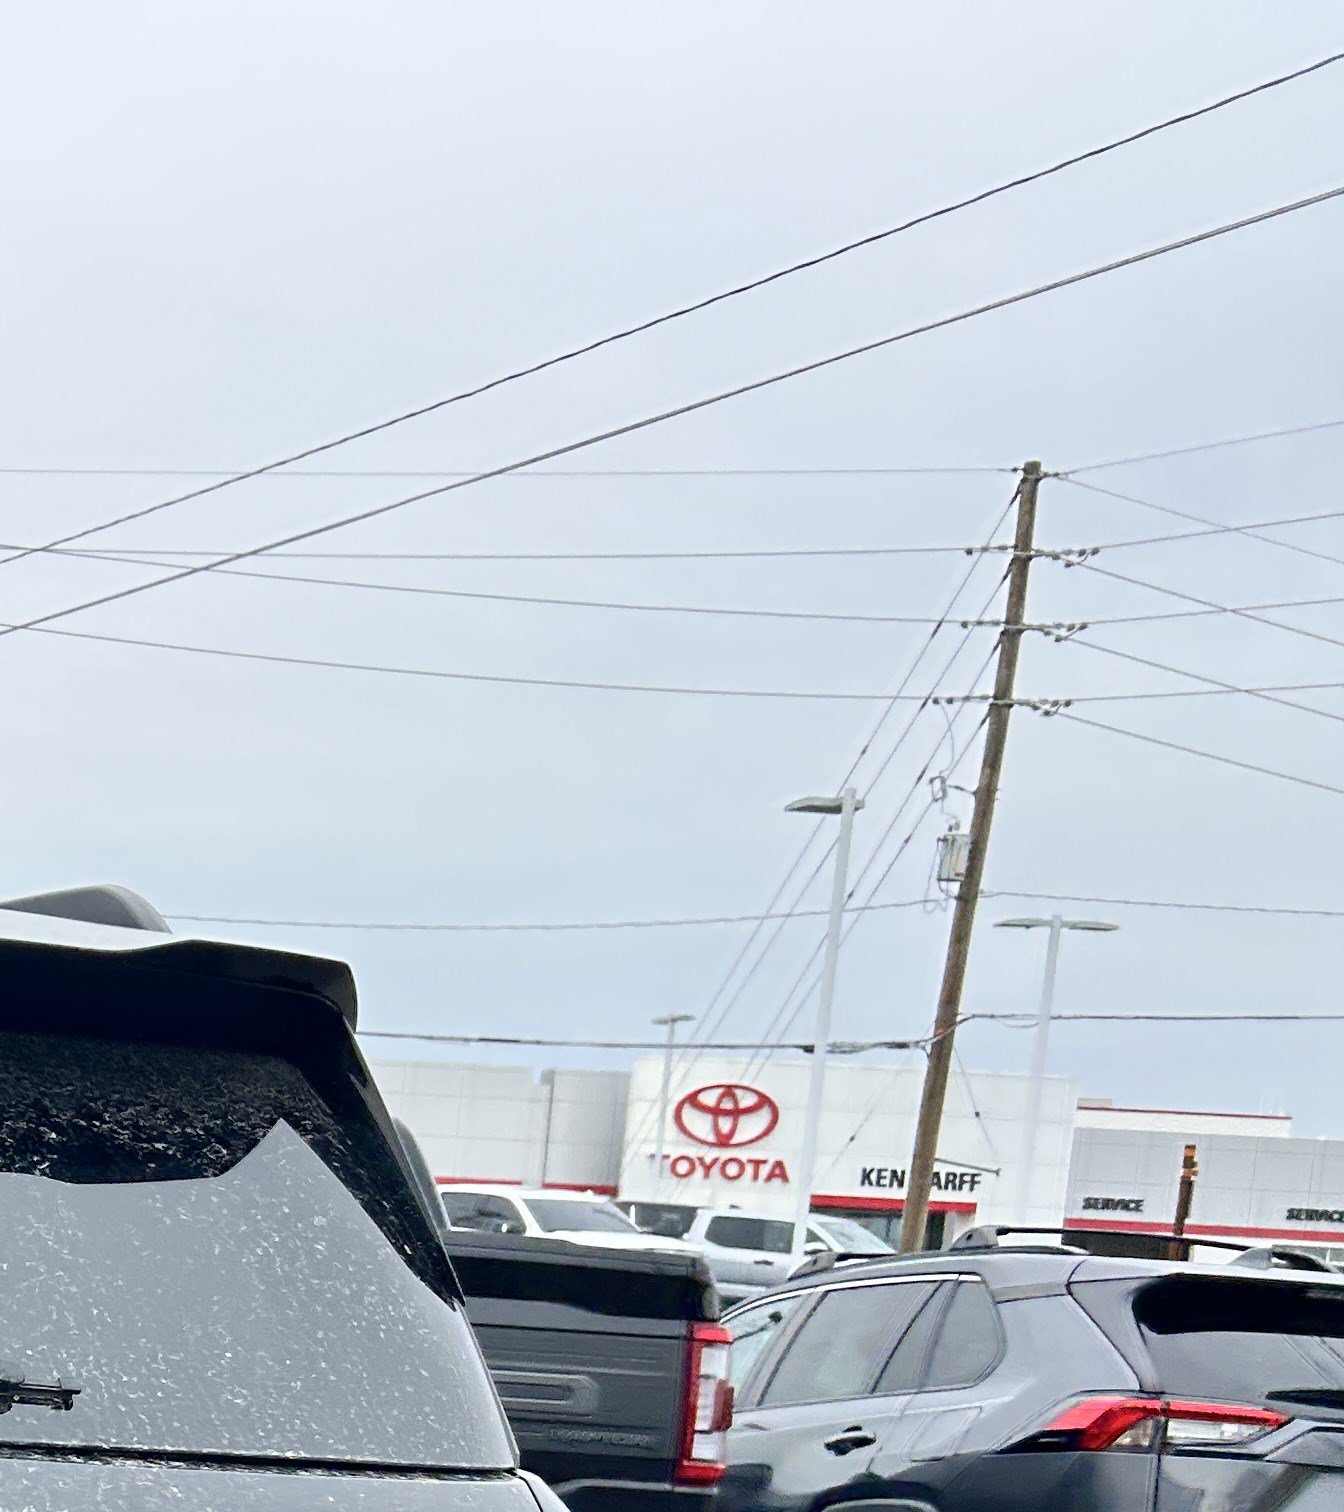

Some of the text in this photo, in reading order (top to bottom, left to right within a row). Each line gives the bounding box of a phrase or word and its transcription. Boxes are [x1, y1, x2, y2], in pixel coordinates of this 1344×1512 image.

[860, 1167, 981, 1193] KEN ARFF
[1082, 1196, 1144, 1213] SERVICE
